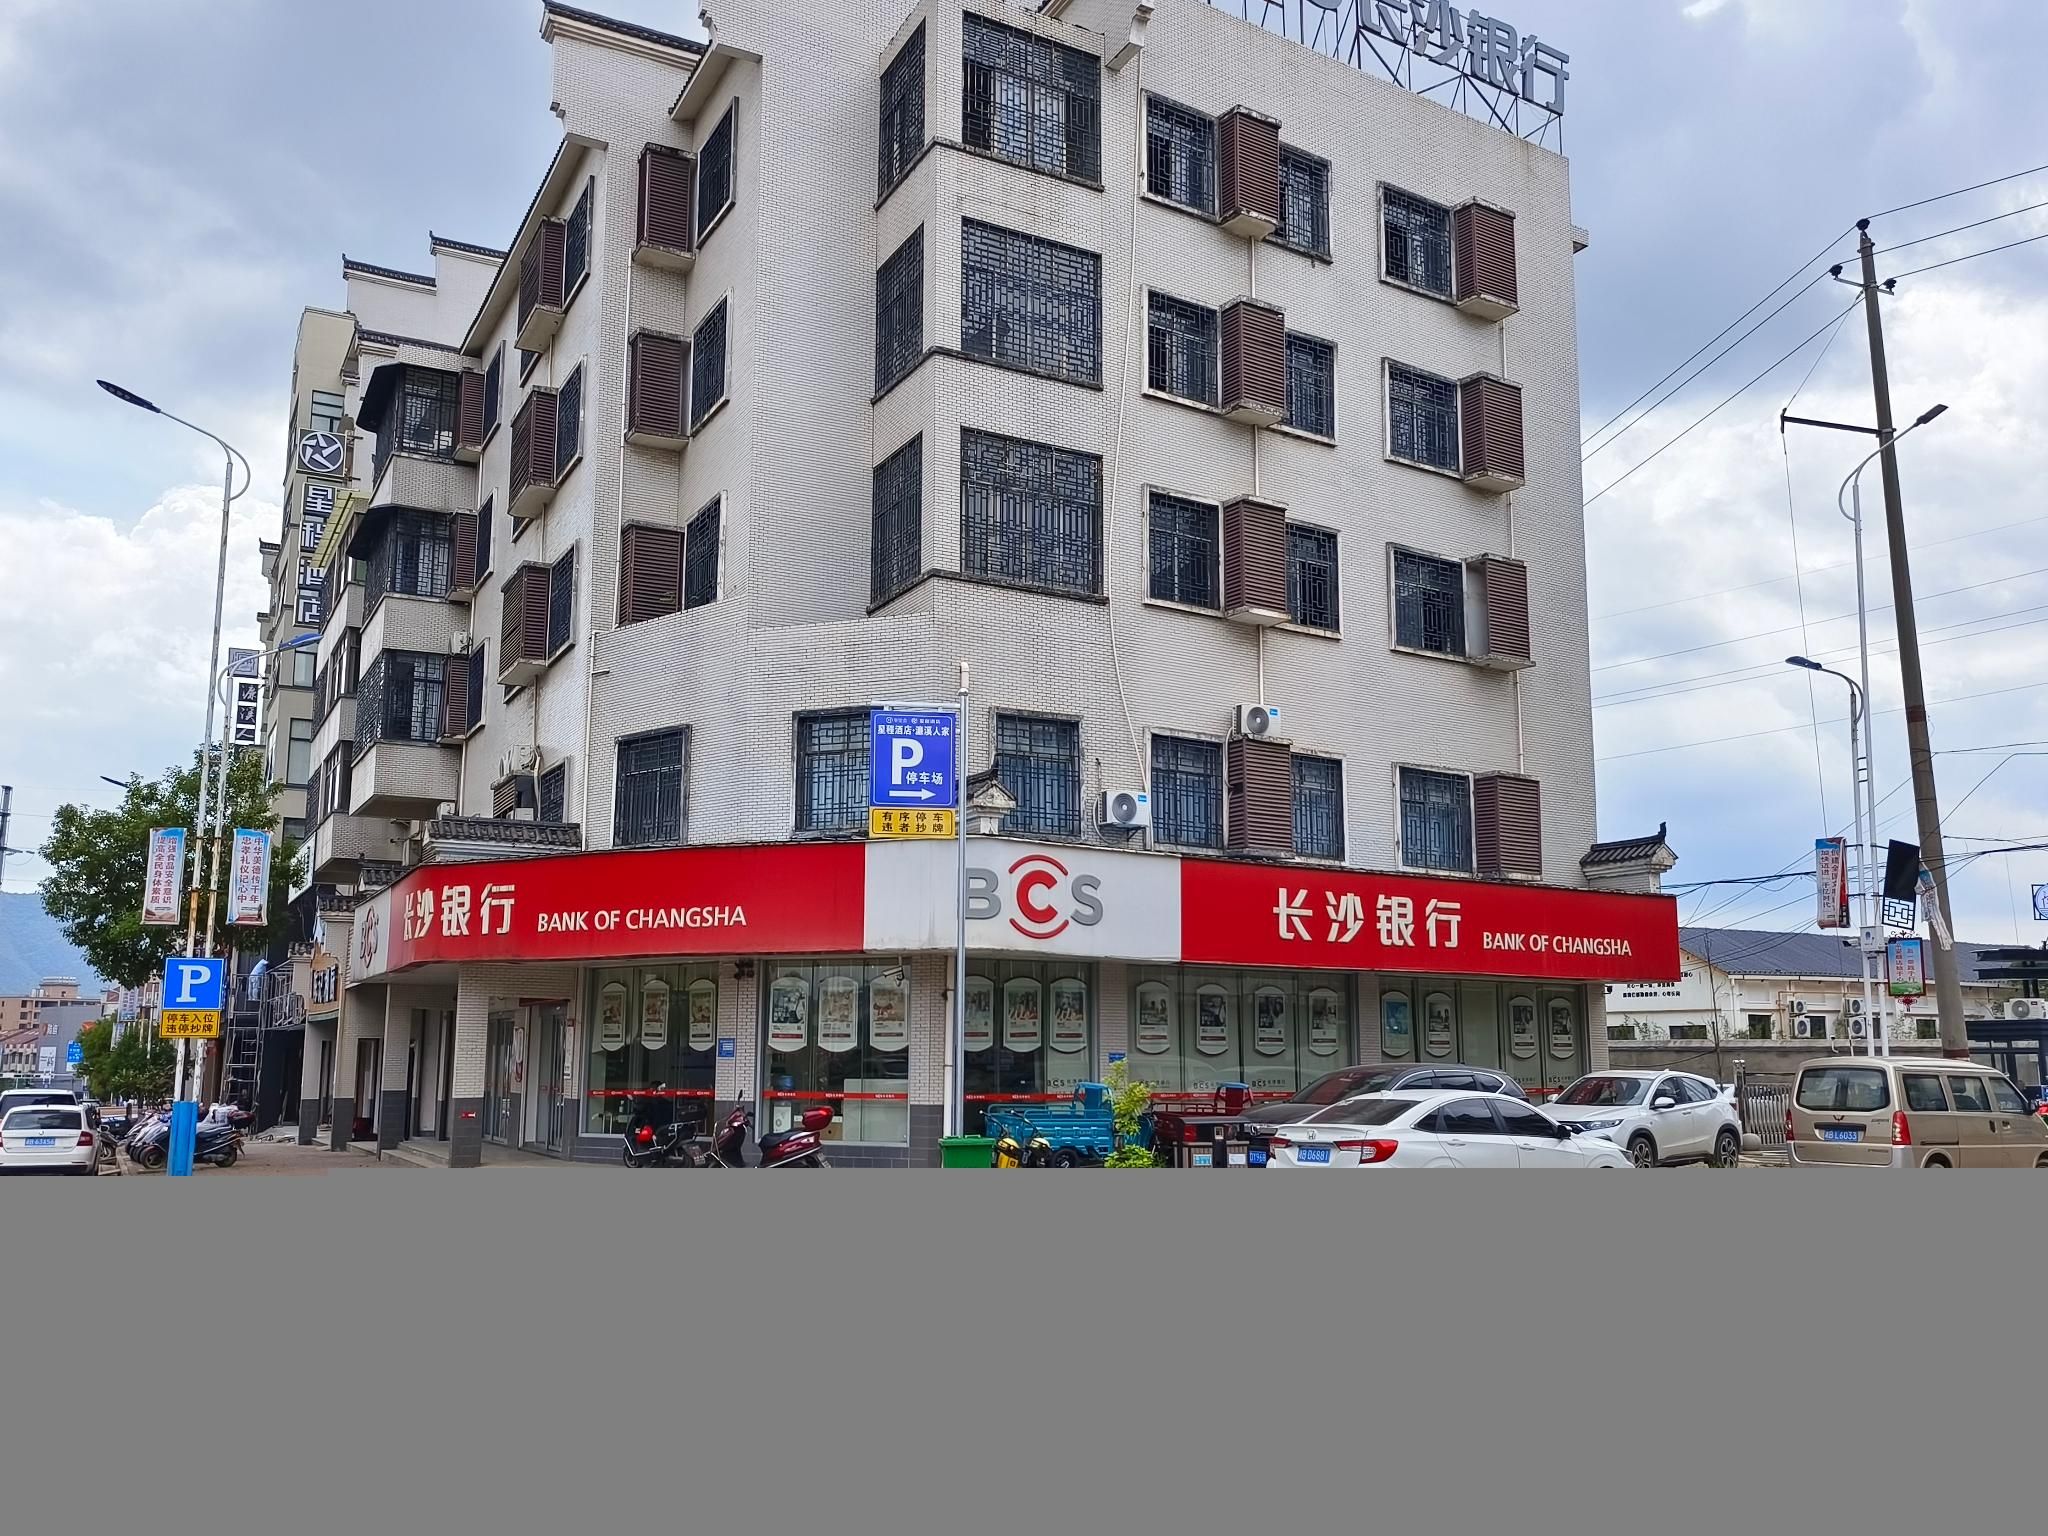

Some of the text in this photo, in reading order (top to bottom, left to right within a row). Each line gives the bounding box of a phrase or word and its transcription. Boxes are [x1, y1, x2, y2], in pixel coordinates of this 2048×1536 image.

[891, 738, 924, 785] P
[905, 771, 944, 785] 停车场
[881, 812, 944, 823] 有序停车
[881, 823, 944, 833] 违者抄牌
[237, 837, 252, 904] 忠孝礼仪记心中
[248, 837, 264, 904] 中华美德传千年
[403, 883, 517, 941] 长沙银行
[964, 866, 1104, 927] BCS
[537, 906, 748, 933] BANK OF CHANGSHA
[1272, 887, 1462, 949] 长沙银行
[1482, 931, 1633, 956] BANK OF CHANGSHA
[175, 964, 212, 1003] P
[165, 1024, 214, 1034] 违停抄牌
[167, 1013, 215, 1023] 停车入位
